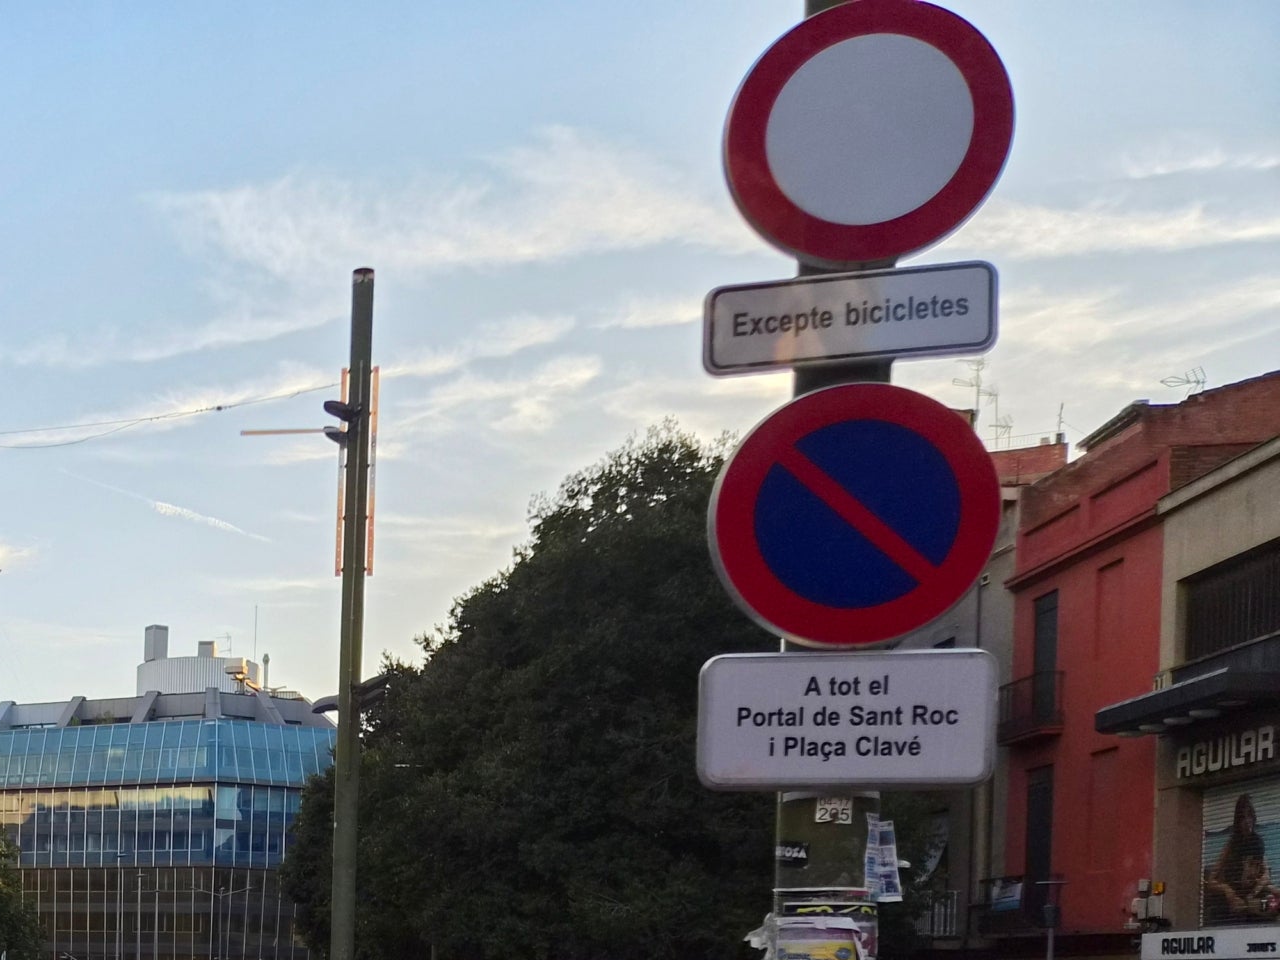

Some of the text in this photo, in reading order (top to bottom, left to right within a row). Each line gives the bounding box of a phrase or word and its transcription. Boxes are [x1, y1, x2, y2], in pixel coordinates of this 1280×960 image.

[733, 296, 969, 337] Excepte bicicletes
[804, 675, 890, 696] A tot el
[737, 705, 959, 727] Portal de Sant Roc
[769, 735, 921, 761] i Plaça Clavé
[1176, 725, 1274, 779] AGUILAR
[1162, 936, 1215, 955] AGUILAR
